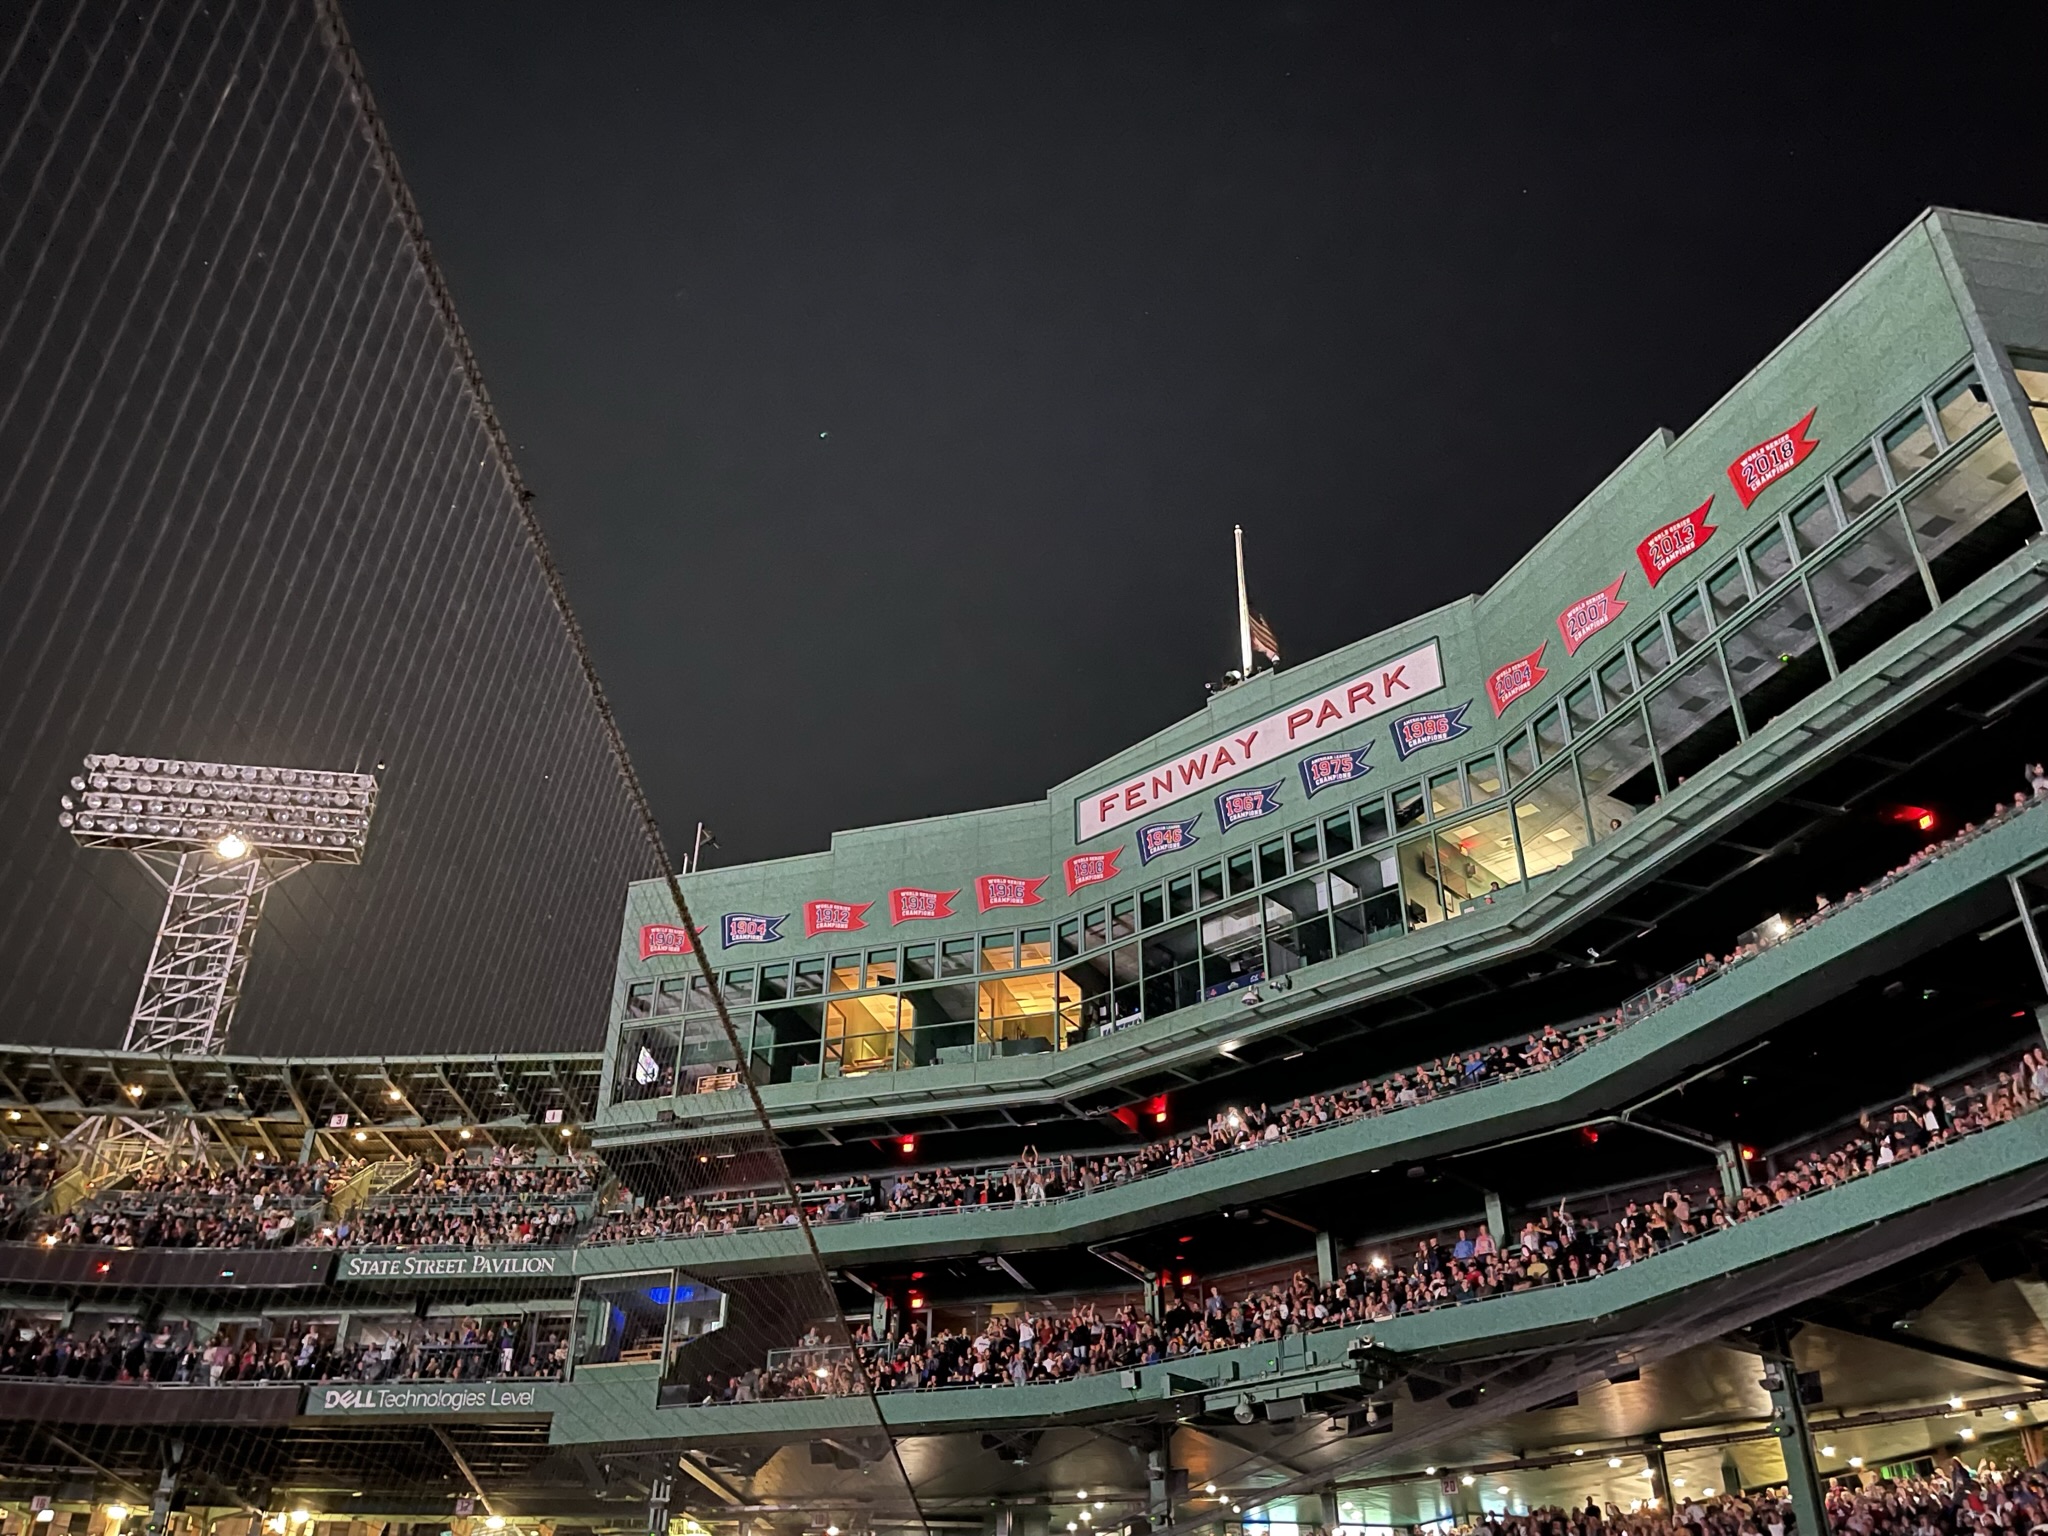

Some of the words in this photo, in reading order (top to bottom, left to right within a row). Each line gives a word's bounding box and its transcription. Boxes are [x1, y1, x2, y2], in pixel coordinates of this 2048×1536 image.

[1740, 448, 1765, 467] WORLD
[1765, 433, 1790, 450] SERIES
[1741, 439, 1794, 487] 2018
[1750, 457, 1795, 491] CHAMPIONS
[1648, 529, 1669, 547] WORLD
[1649, 522, 1695, 567] 2013
[1657, 541, 1696, 570] CHAMPIONS
[1567, 596, 1608, 637] 2007
[1574, 614, 1609, 641] CHAMPIONS
[1495, 664, 1532, 699] 2004
[1402, 717, 1449, 743] 1986
[1403, 716, 1427, 726] AMERICAN
[1099, 730, 1259, 822] FENWAY
[1287, 664, 1411, 740] PARK
[1408, 732, 1448, 748] CHAMPIONS
[1311, 756, 1353, 780] 1975
[1315, 771, 1352, 786] CHAMPIONS
[1225, 794, 1264, 817] 1967
[1230, 808, 1263, 822] CHAMPIONS
[1146, 828, 1182, 850] 1946
[1074, 860, 1105, 879] 1918
[989, 883, 1026, 898] 1916
[901, 895, 937, 911] 1915
[815, 908, 850, 923] 1912
[730, 920, 767, 936] 1904
[649, 932, 685, 947] 1903
[348, 1257, 401, 1276] STATE
[471, 1255, 557, 1274] PAVILION
[324, 1390, 376, 1409] DELL
[377, 1388, 486, 1412] Technologies
[490, 1386, 536, 1407] Level
[1443, 1480, 1456, 1493] 20
